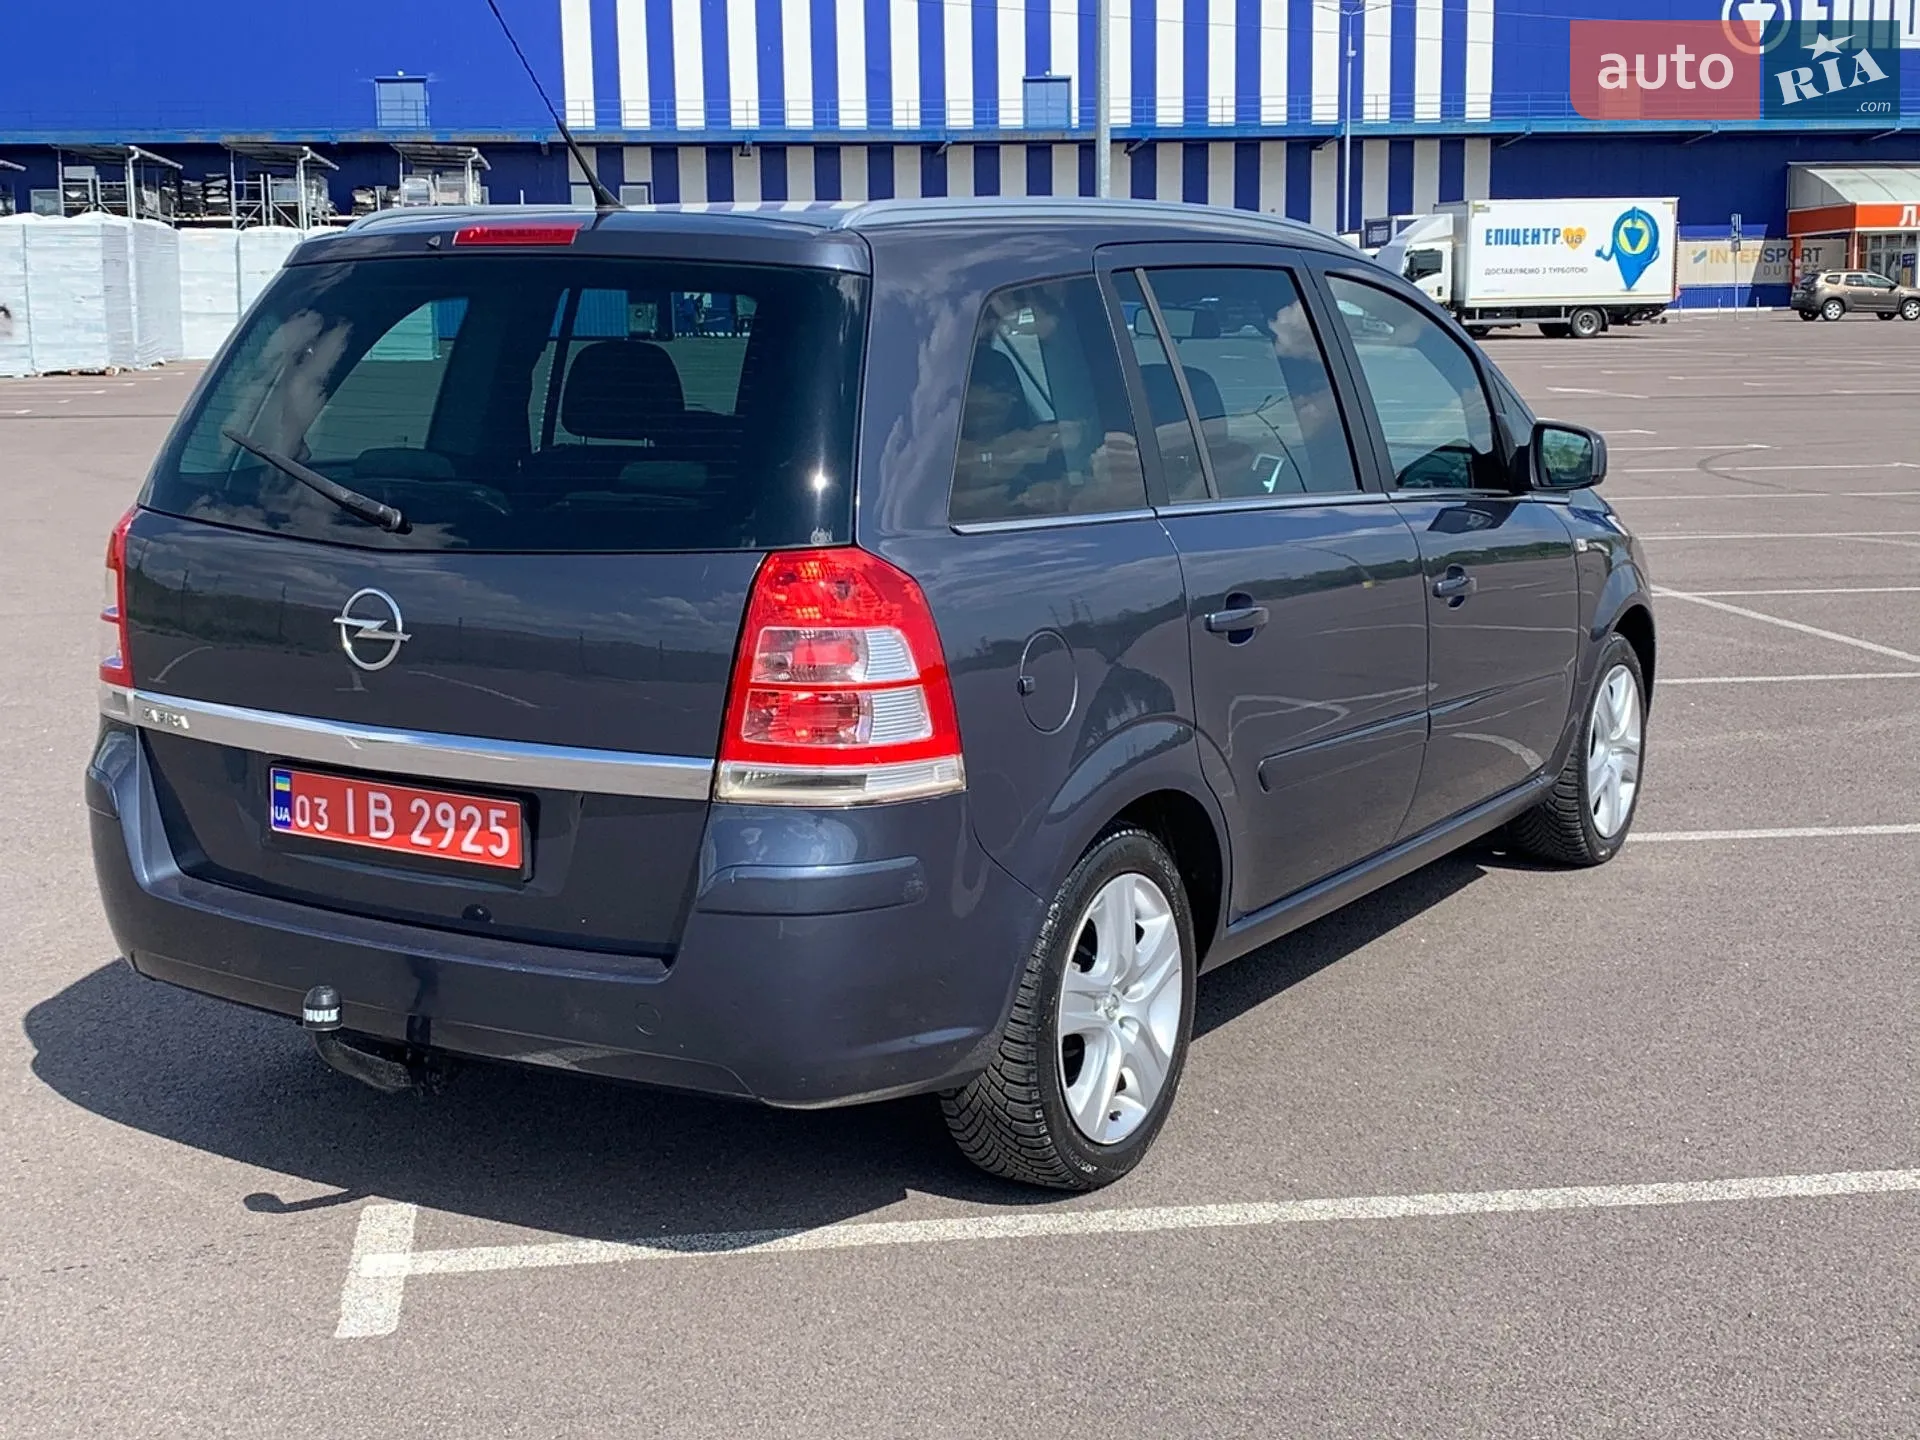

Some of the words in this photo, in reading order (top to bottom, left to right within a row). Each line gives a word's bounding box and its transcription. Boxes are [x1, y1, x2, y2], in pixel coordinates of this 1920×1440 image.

[275, 806, 290, 822] UA
[295, 795, 329, 832] 03
[409, 798, 510, 857] 2925
